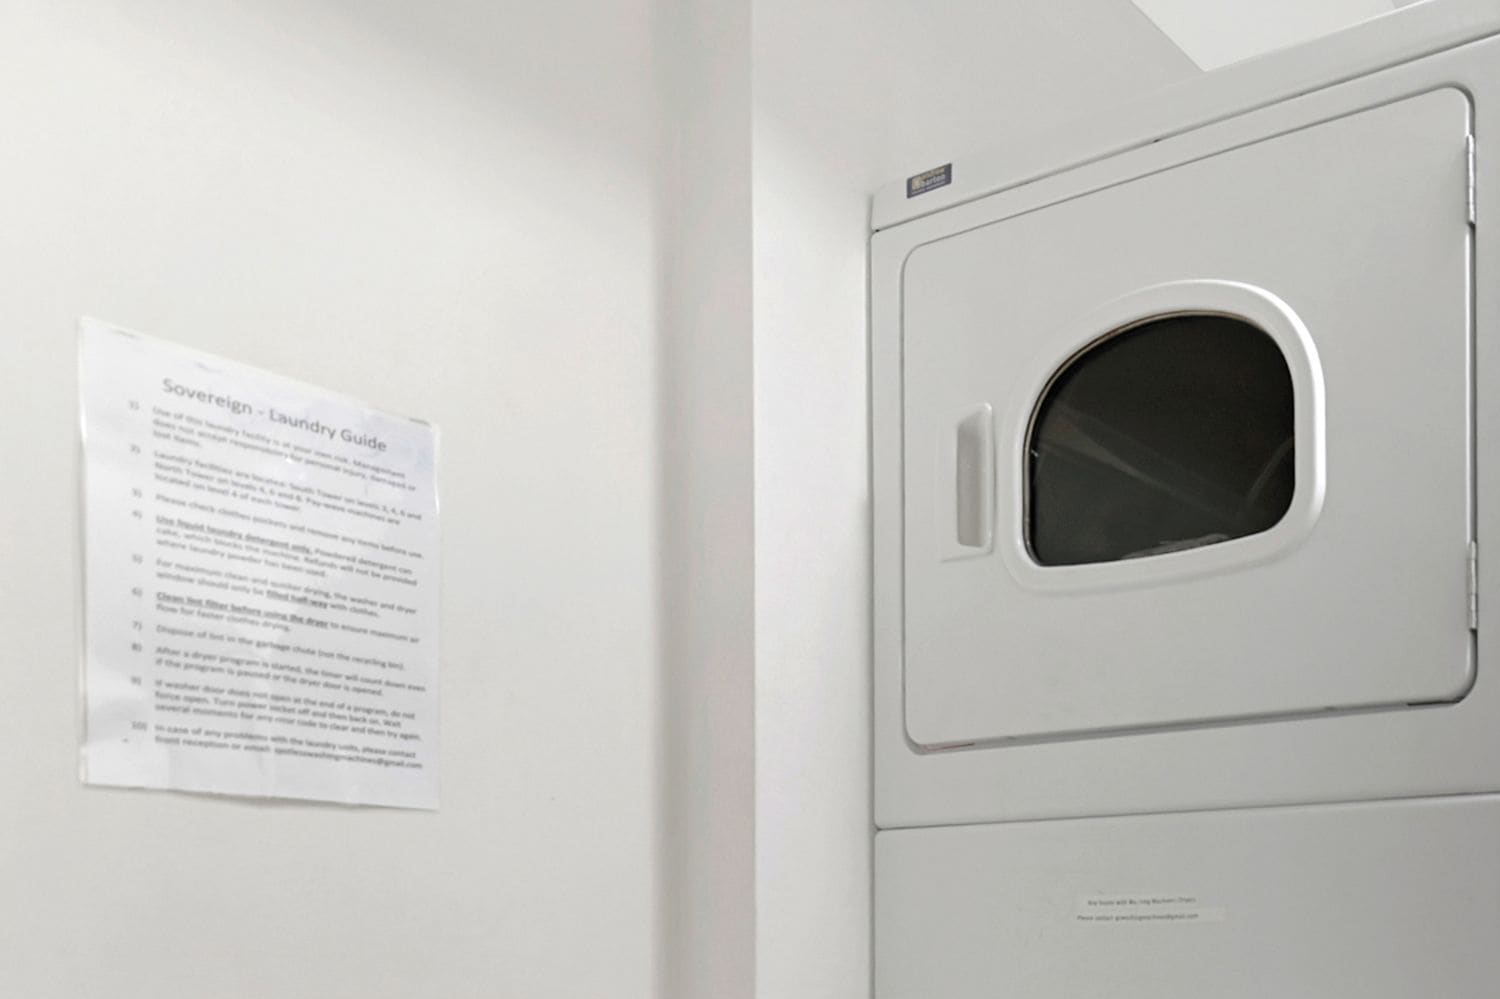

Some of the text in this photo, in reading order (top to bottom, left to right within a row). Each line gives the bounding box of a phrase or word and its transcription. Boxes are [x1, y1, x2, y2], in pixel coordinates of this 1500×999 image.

[162, 377, 253, 415] Sovereign
[269, 408, 337, 440] Laundry
[340, 428, 387, 452] Guide
